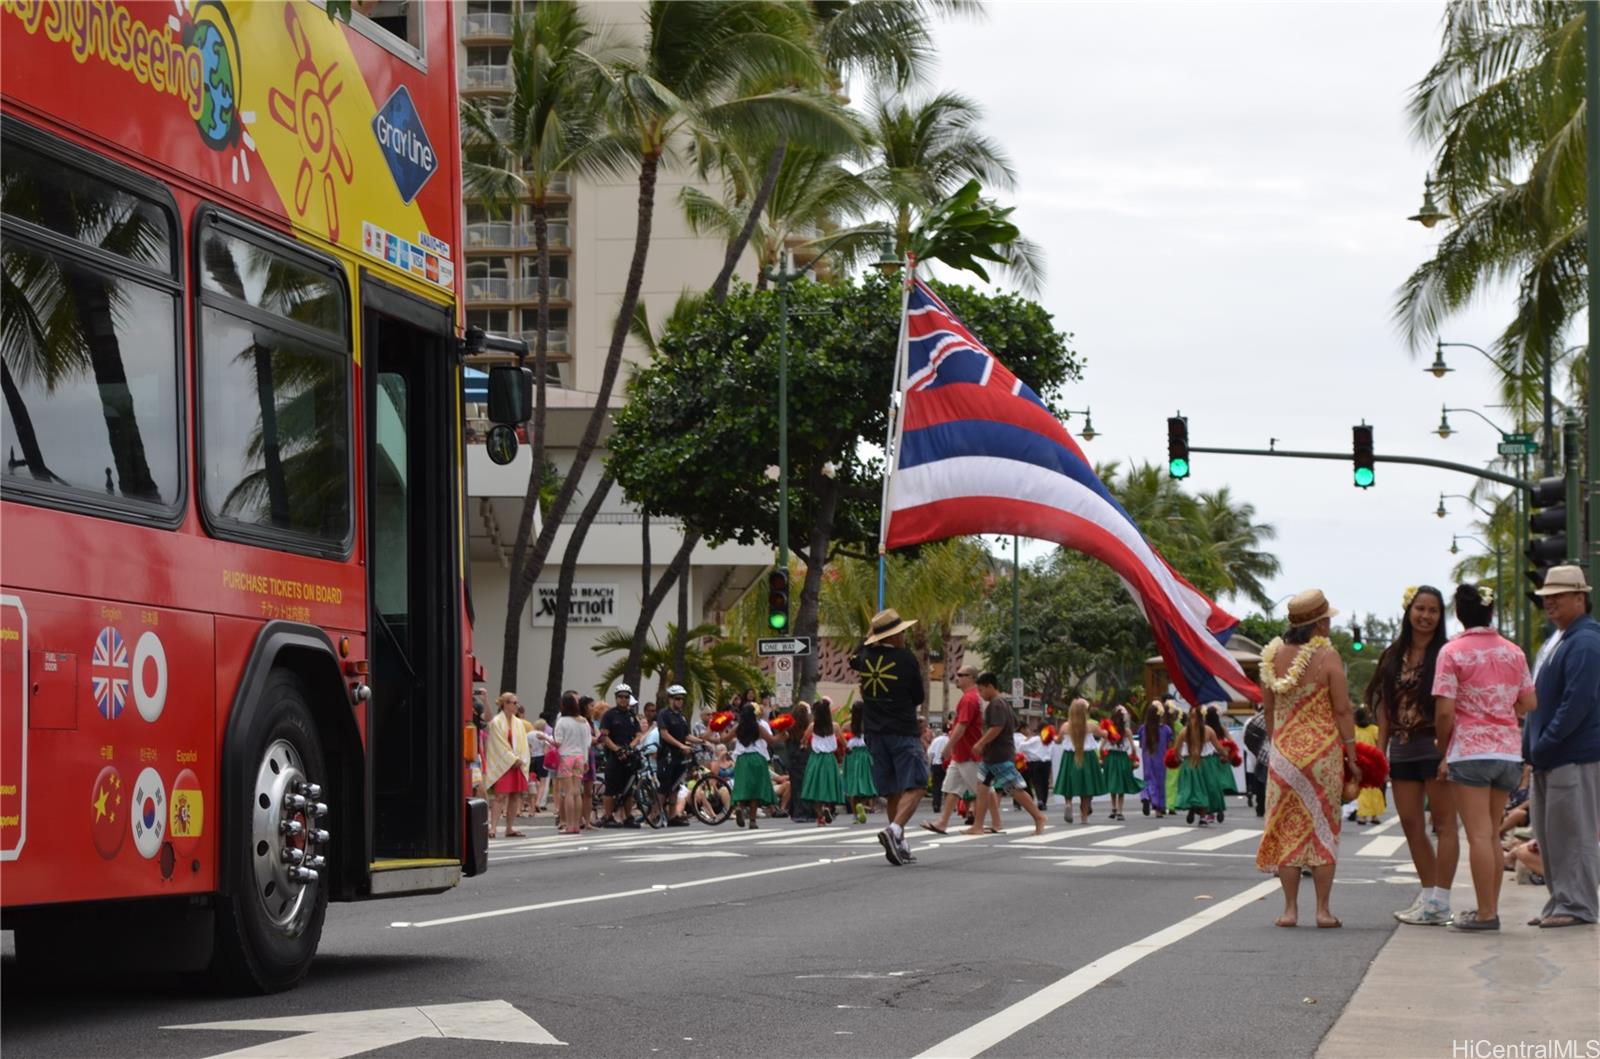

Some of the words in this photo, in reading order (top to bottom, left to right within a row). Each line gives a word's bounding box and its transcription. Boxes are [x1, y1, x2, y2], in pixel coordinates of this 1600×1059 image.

[223, 570, 268, 594] PURCHASE
[269, 578, 302, 599] TICKETS
[303, 583, 315, 600] ON
[316, 586, 342, 605] BOARD
[581, 588, 614, 597] BEACH
[101, 605, 122, 622] English
[782, 642, 796, 650] WAY
[45, 652, 57, 662] FUEL
[44, 662, 58, 672] DOOR
[176, 749, 198, 765] Español
